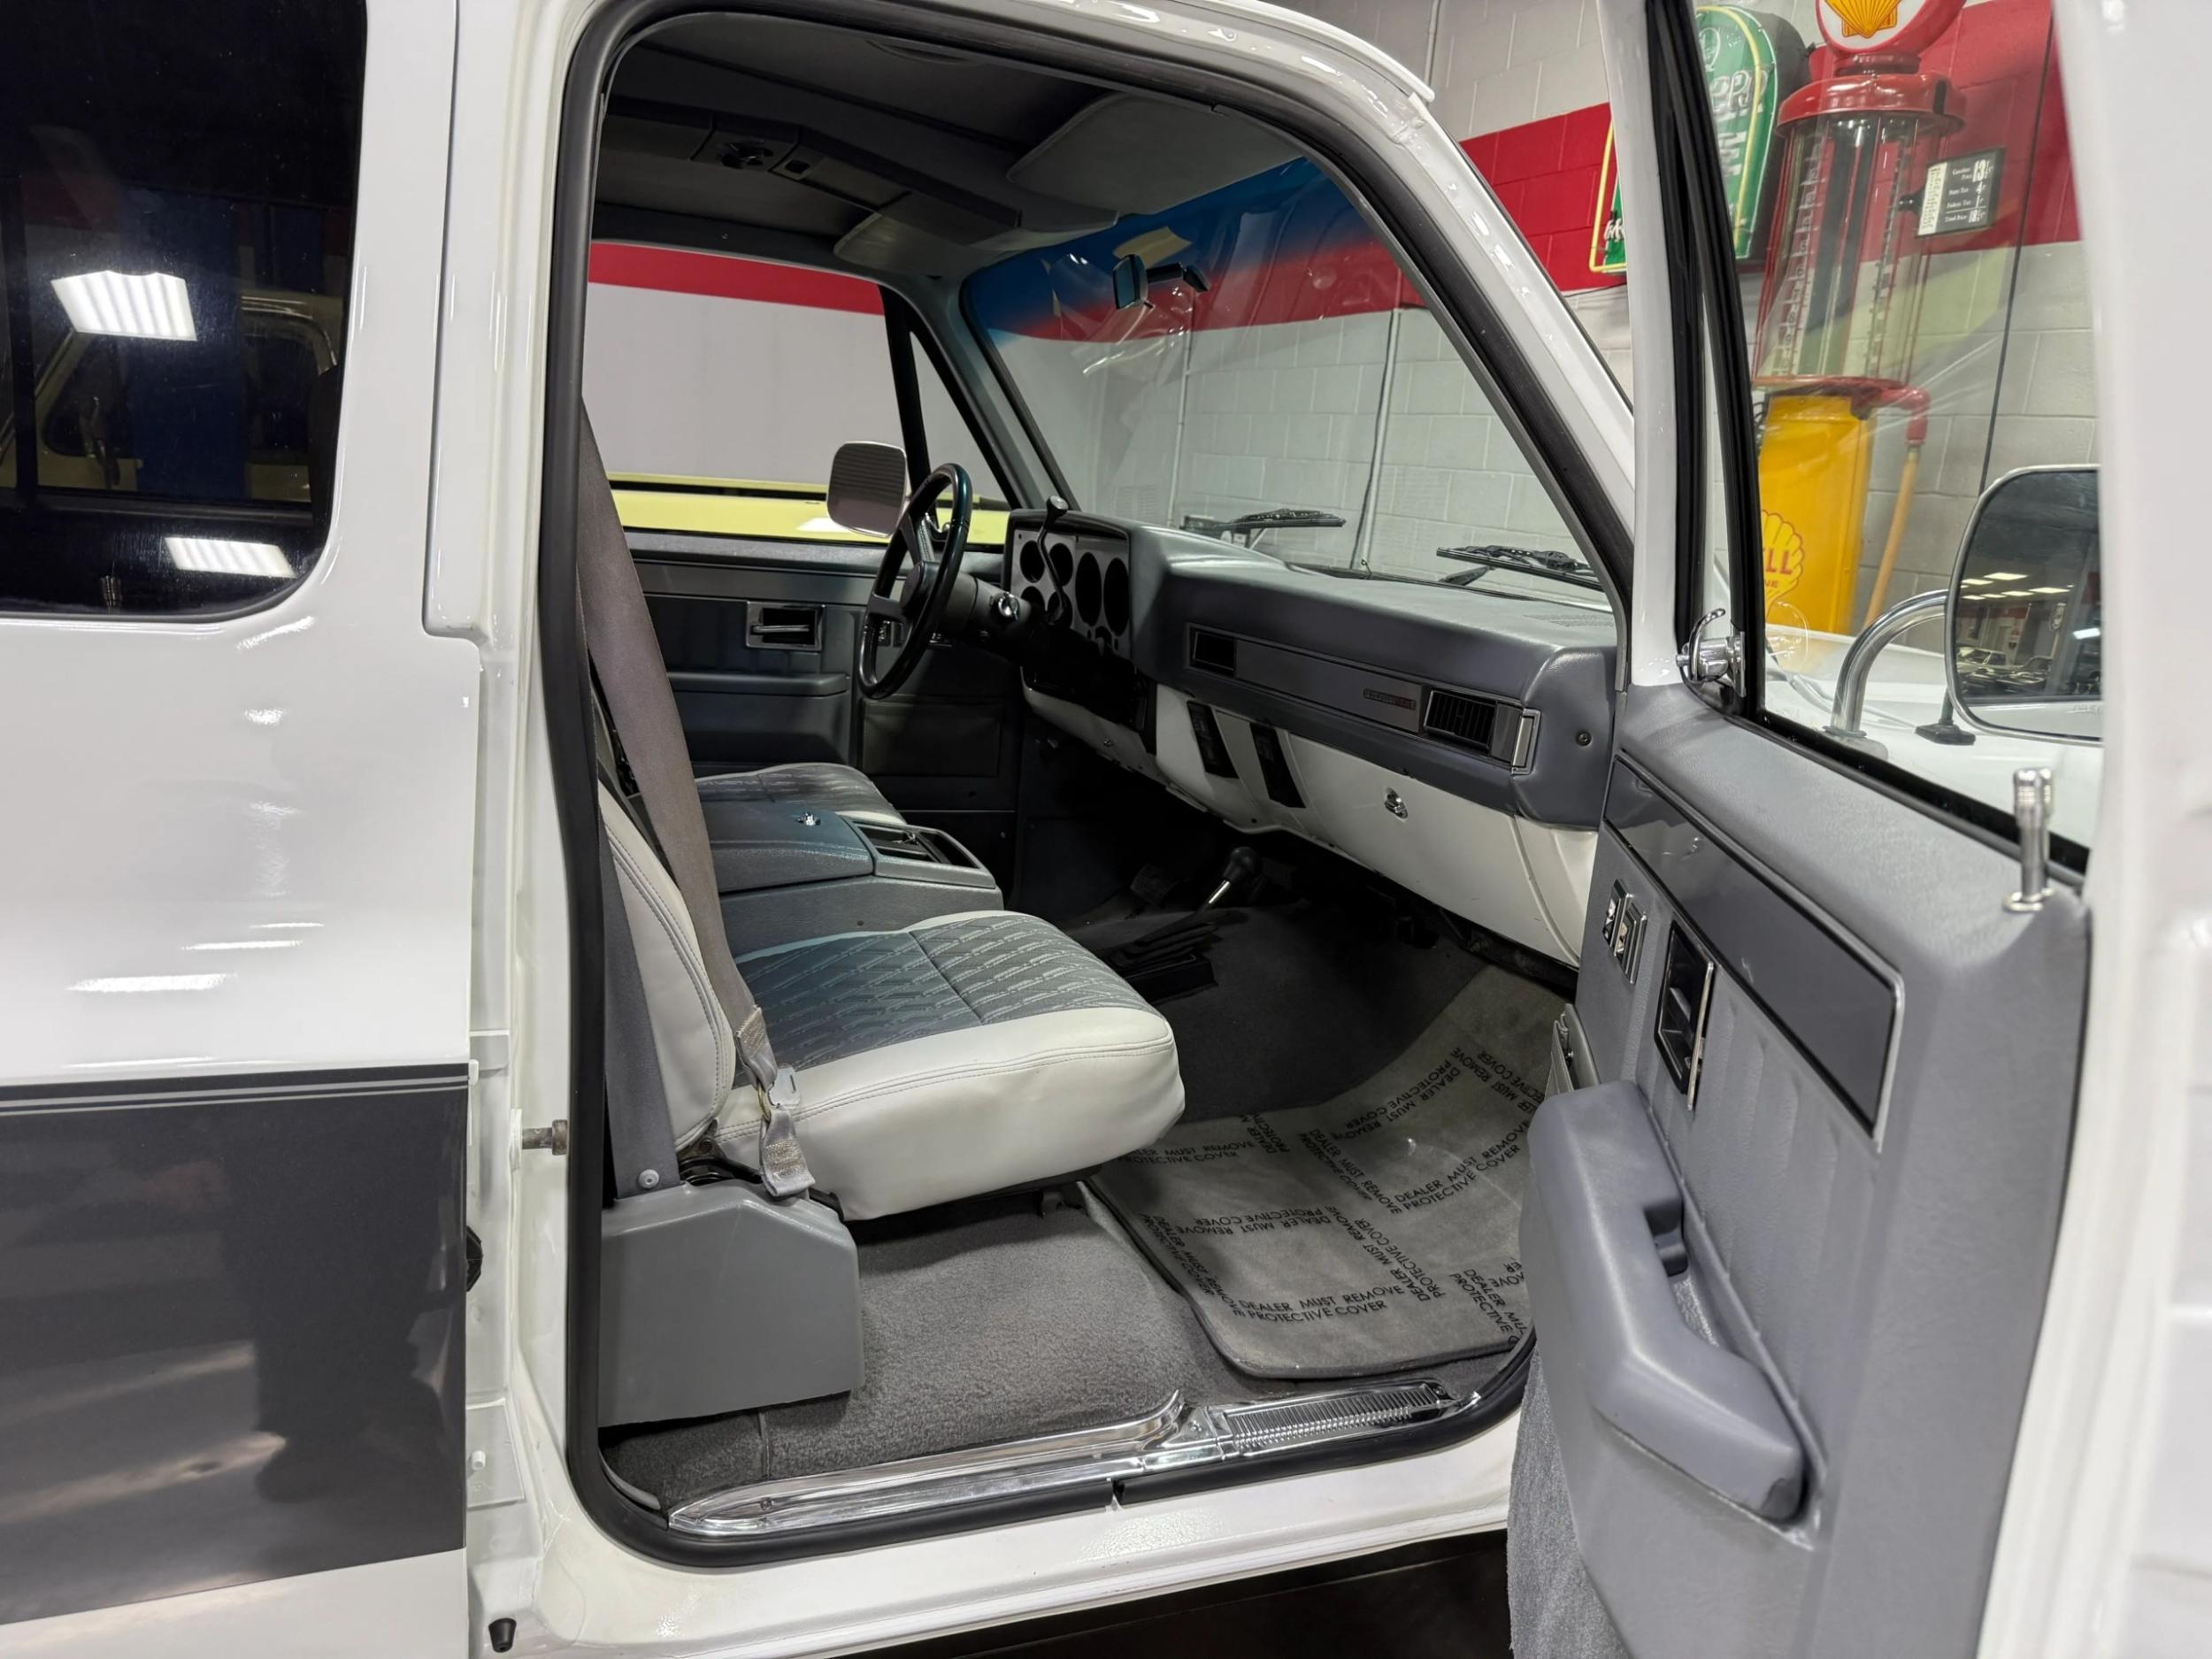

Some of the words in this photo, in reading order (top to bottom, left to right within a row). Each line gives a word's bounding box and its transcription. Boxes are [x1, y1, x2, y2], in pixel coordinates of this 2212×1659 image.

[1450, 1047, 1493, 1082] REMOVE
[1477, 1049, 1514, 1079] COVER
[1387, 1059, 1452, 1109] PROTECTIVE
[1419, 1067, 1461, 1101] DEALER
[1490, 1080, 1519, 1101] MUST
[1345, 1106, 1387, 1129] COVER
[1386, 1100, 1416, 1122] MUST
[1331, 1120, 1381, 1140] REMOVE
[1164, 1148, 1195, 1157] MUST
[1202, 1141, 1256, 1151] REMOVE
[1195, 1151, 1238, 1163] COVER
[1394, 1179, 1443, 1203] DEALER
[1447, 1156, 1478, 1183] MUST
[1481, 1119, 1530, 1159] REMOVE
[1310, 1128, 1341, 1157] DEALER
[1339, 1158, 1365, 1179] MUST
[1362, 1179, 1403, 1215] REMOVE
[1402, 1169, 1478, 1211] PROTECTIVE
[1475, 1144, 1522, 1172] COVER
[1195, 1216, 1242, 1226] COVER
[1240, 1222, 1276, 1233] MUST
[1245, 1207, 1324, 1223] PROTECTIVE
[1282, 1216, 1332, 1229] DEALER
[1325, 1204, 1365, 1241] REMOVE
[1177, 1225, 1233, 1235] REMOVE
[1354, 1217, 1390, 1247] COVER
[1153, 1215, 1186, 1247] DEALER
[1204, 1275, 1246, 1317] REMOVE
[1363, 1243, 1393, 1266] MUST
[1385, 1244, 1447, 1300] PROTECTIVE
[1390, 1268, 1432, 1302] DEALER
[1239, 1299, 1294, 1312] DEALER
[1299, 1295, 1338, 1310] MUST
[1341, 1285, 1405, 1304] REMOVE
[1463, 1268, 1507, 1307] DEALER
[1248, 1307, 1334, 1323] PROTECTIVE
[1334, 1300, 1389, 1316] COVER
[1448, 1272, 1515, 1333] PROTECTIVE
